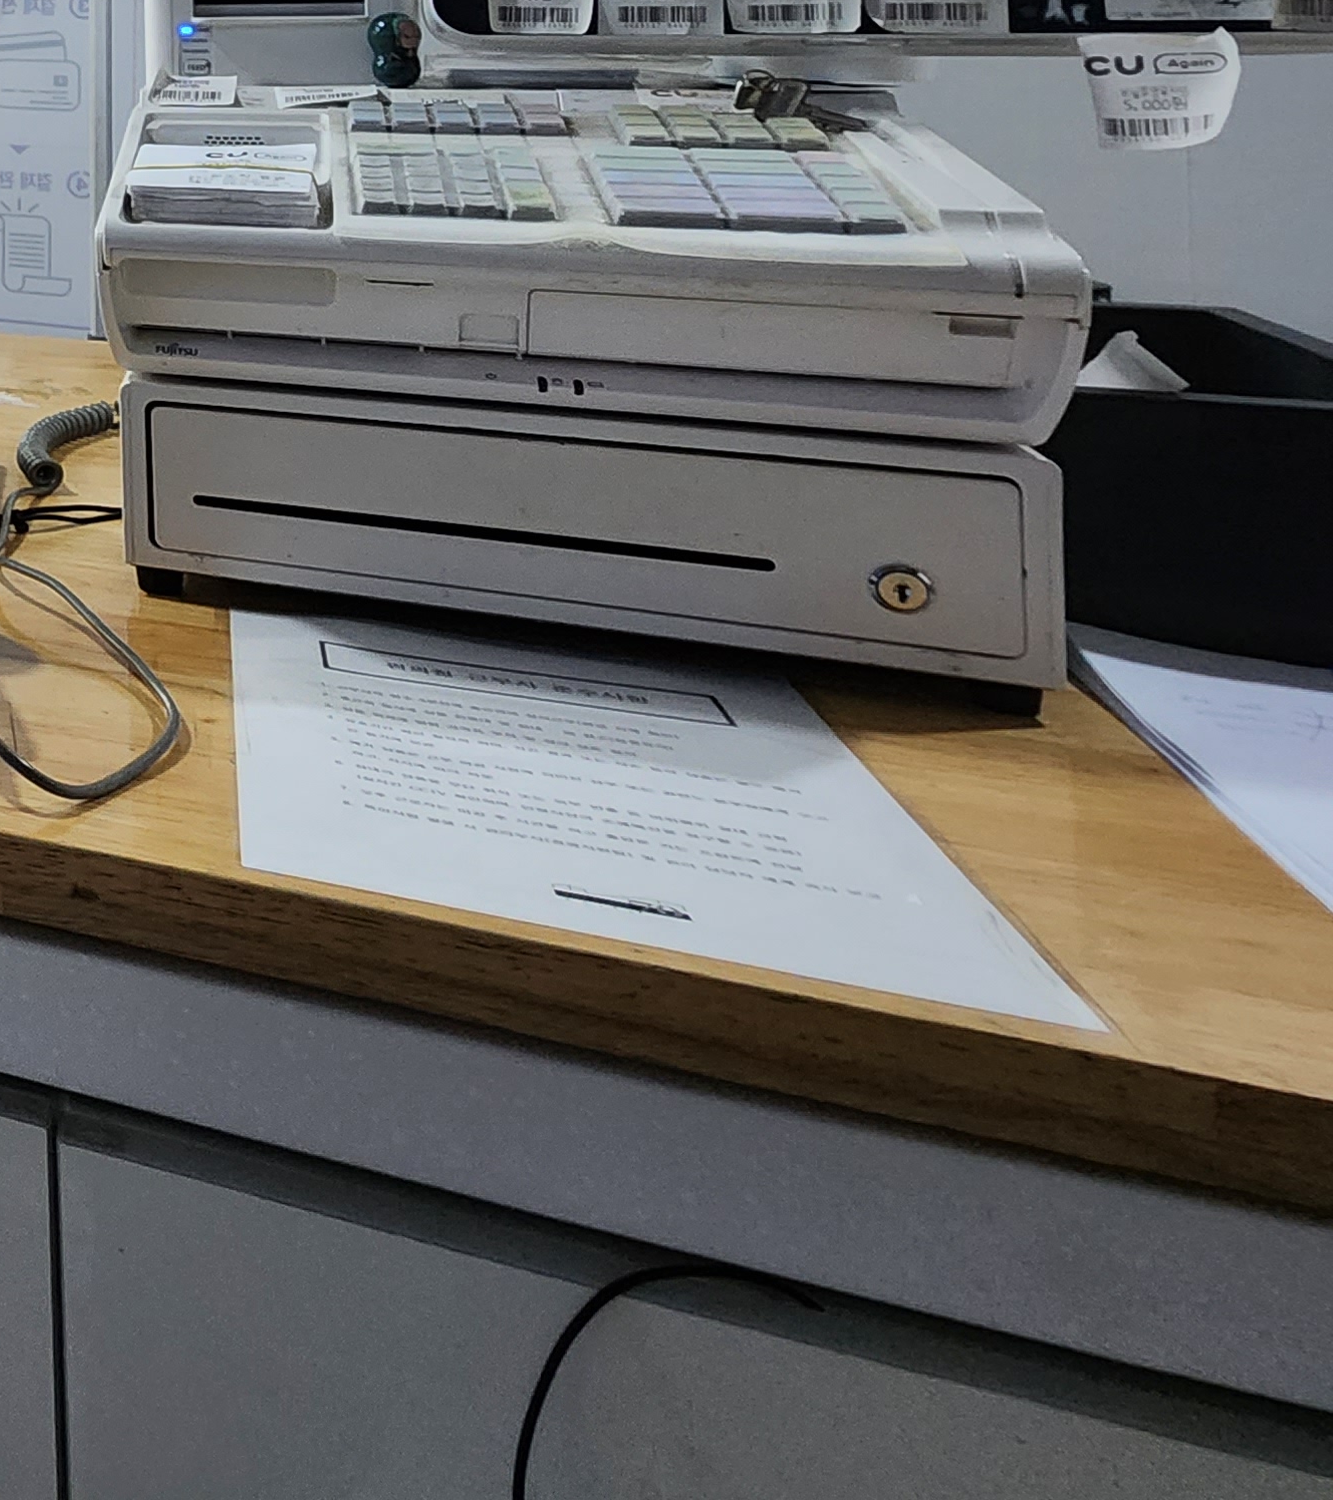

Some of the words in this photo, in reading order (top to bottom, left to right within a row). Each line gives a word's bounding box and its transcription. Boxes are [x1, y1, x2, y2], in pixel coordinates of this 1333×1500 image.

[1084, 54, 1145, 77] CU
[1167, 58, 1216, 70] Again
[155, 342, 199, 357] FUJITSU
